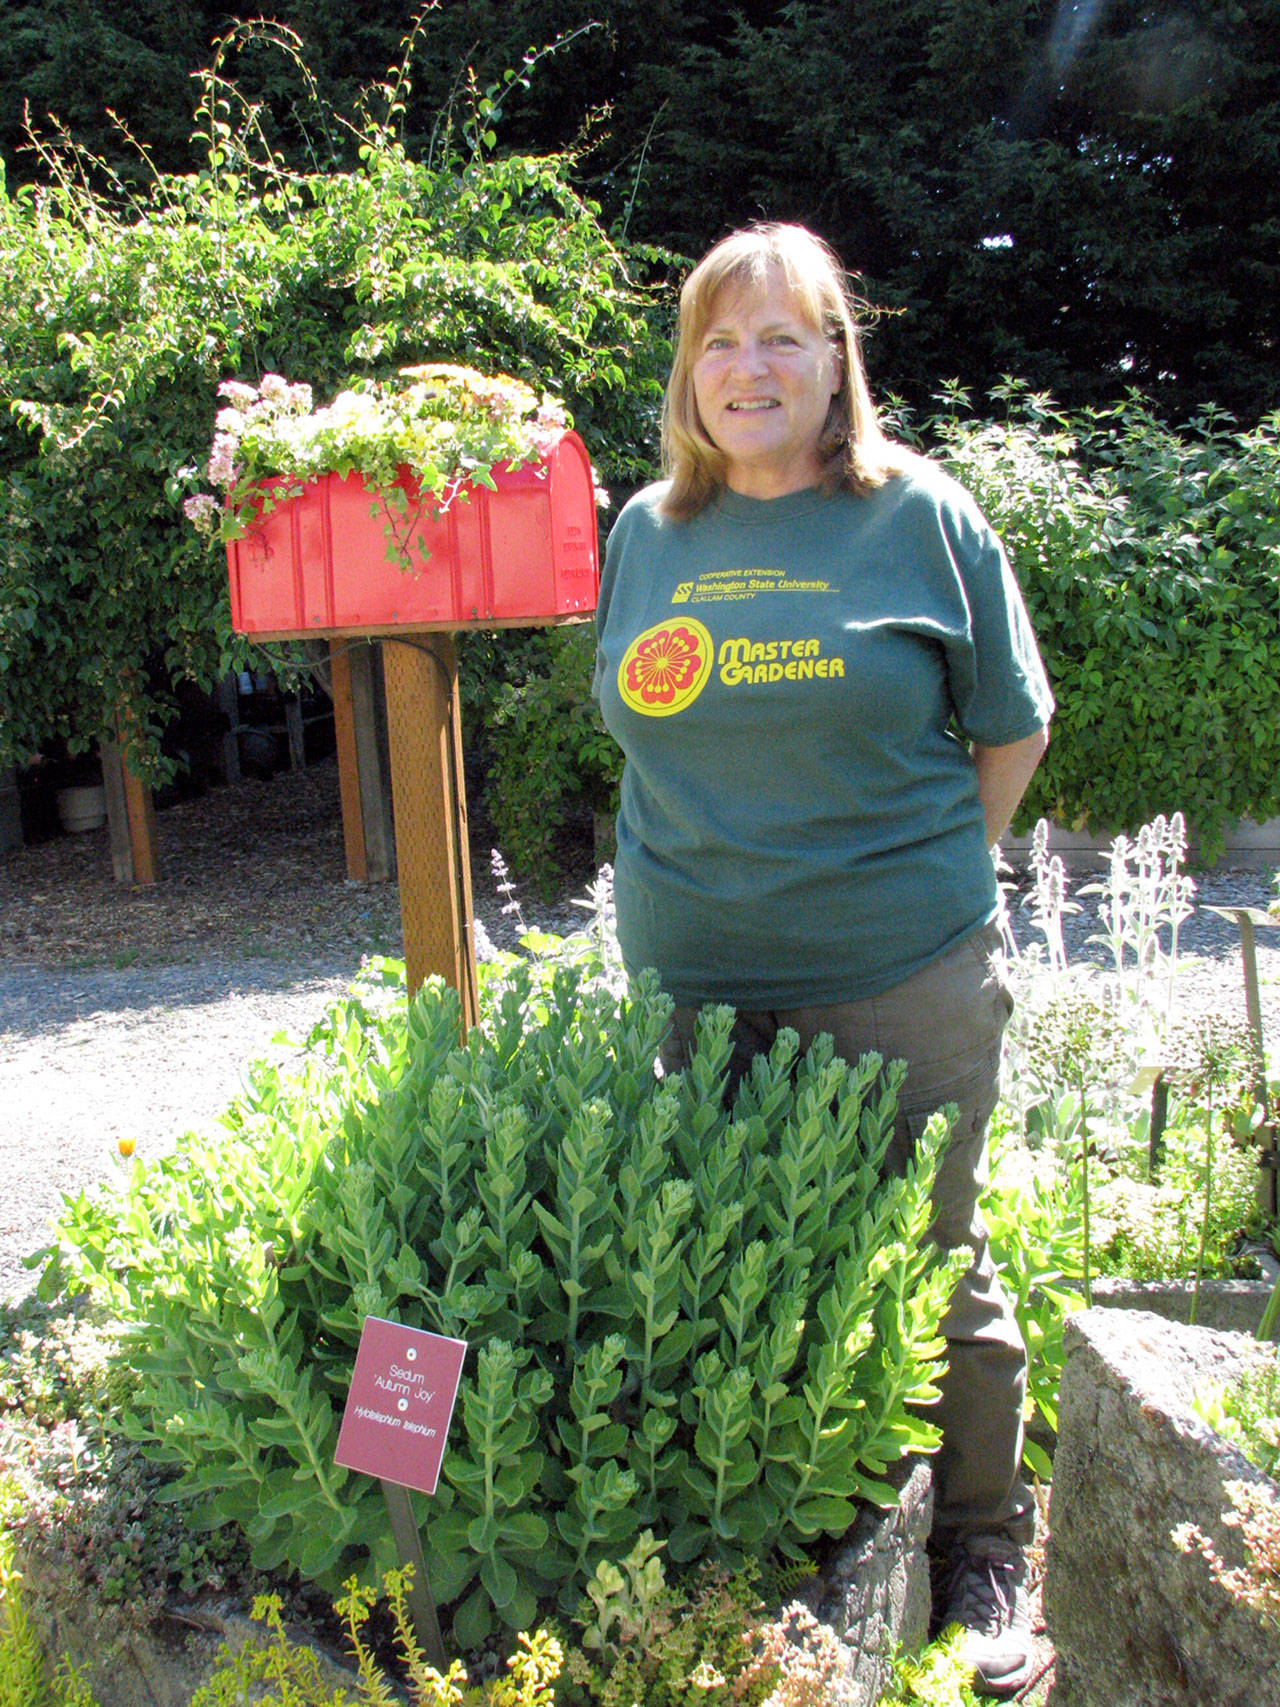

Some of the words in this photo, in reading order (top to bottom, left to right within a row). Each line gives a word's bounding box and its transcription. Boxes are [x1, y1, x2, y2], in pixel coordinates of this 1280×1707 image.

[699, 570, 743, 581] COOPERATIVE
[743, 568, 787, 578] EXTENSION
[695, 580, 747, 593] Washington
[748, 579, 775, 589] State
[778, 579, 830, 590] University
[691, 593, 723, 603] CLALLAM
[724, 592, 756, 601] COUNTY
[720, 658, 845, 686] GARDENER
[390, 1364, 424, 1384] Sedum
